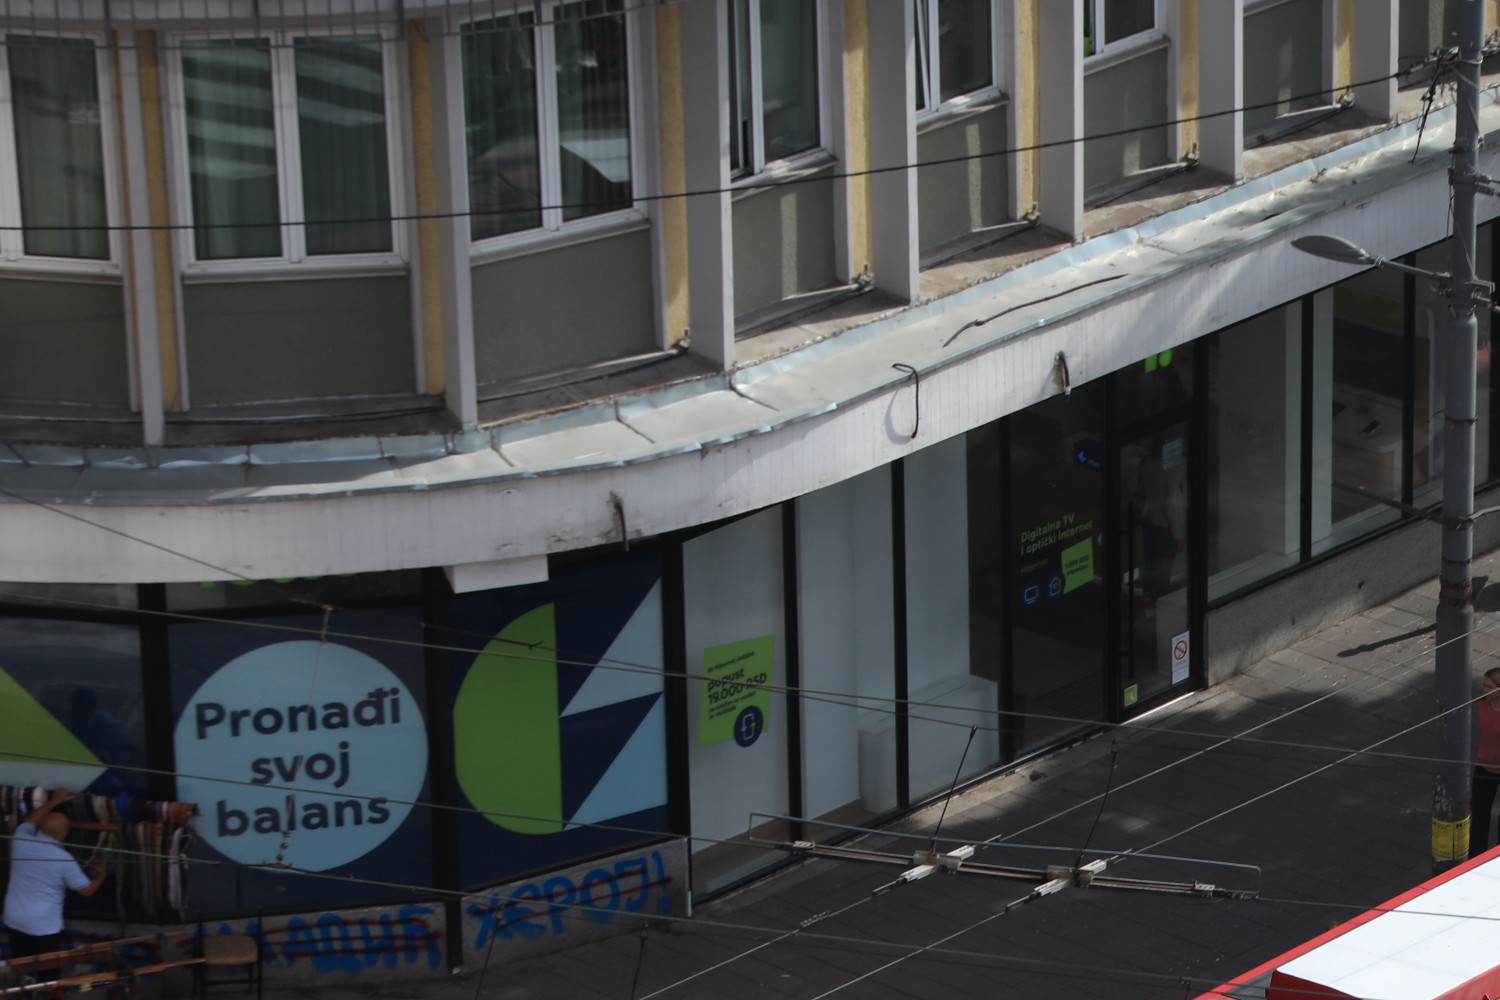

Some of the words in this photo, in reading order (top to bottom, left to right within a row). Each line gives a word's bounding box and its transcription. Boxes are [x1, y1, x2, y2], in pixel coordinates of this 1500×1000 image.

[1020, 519, 1061, 543] Digitalna
[1063, 512, 1075, 525] TV
[1058, 520, 1094, 541] internet
[708, 668, 745, 693] popust
[708, 682, 743, 704] 19.000
[195, 687, 402, 740] Pronađi
[250, 742, 351, 788] svoj
[216, 794, 391, 838] balans
